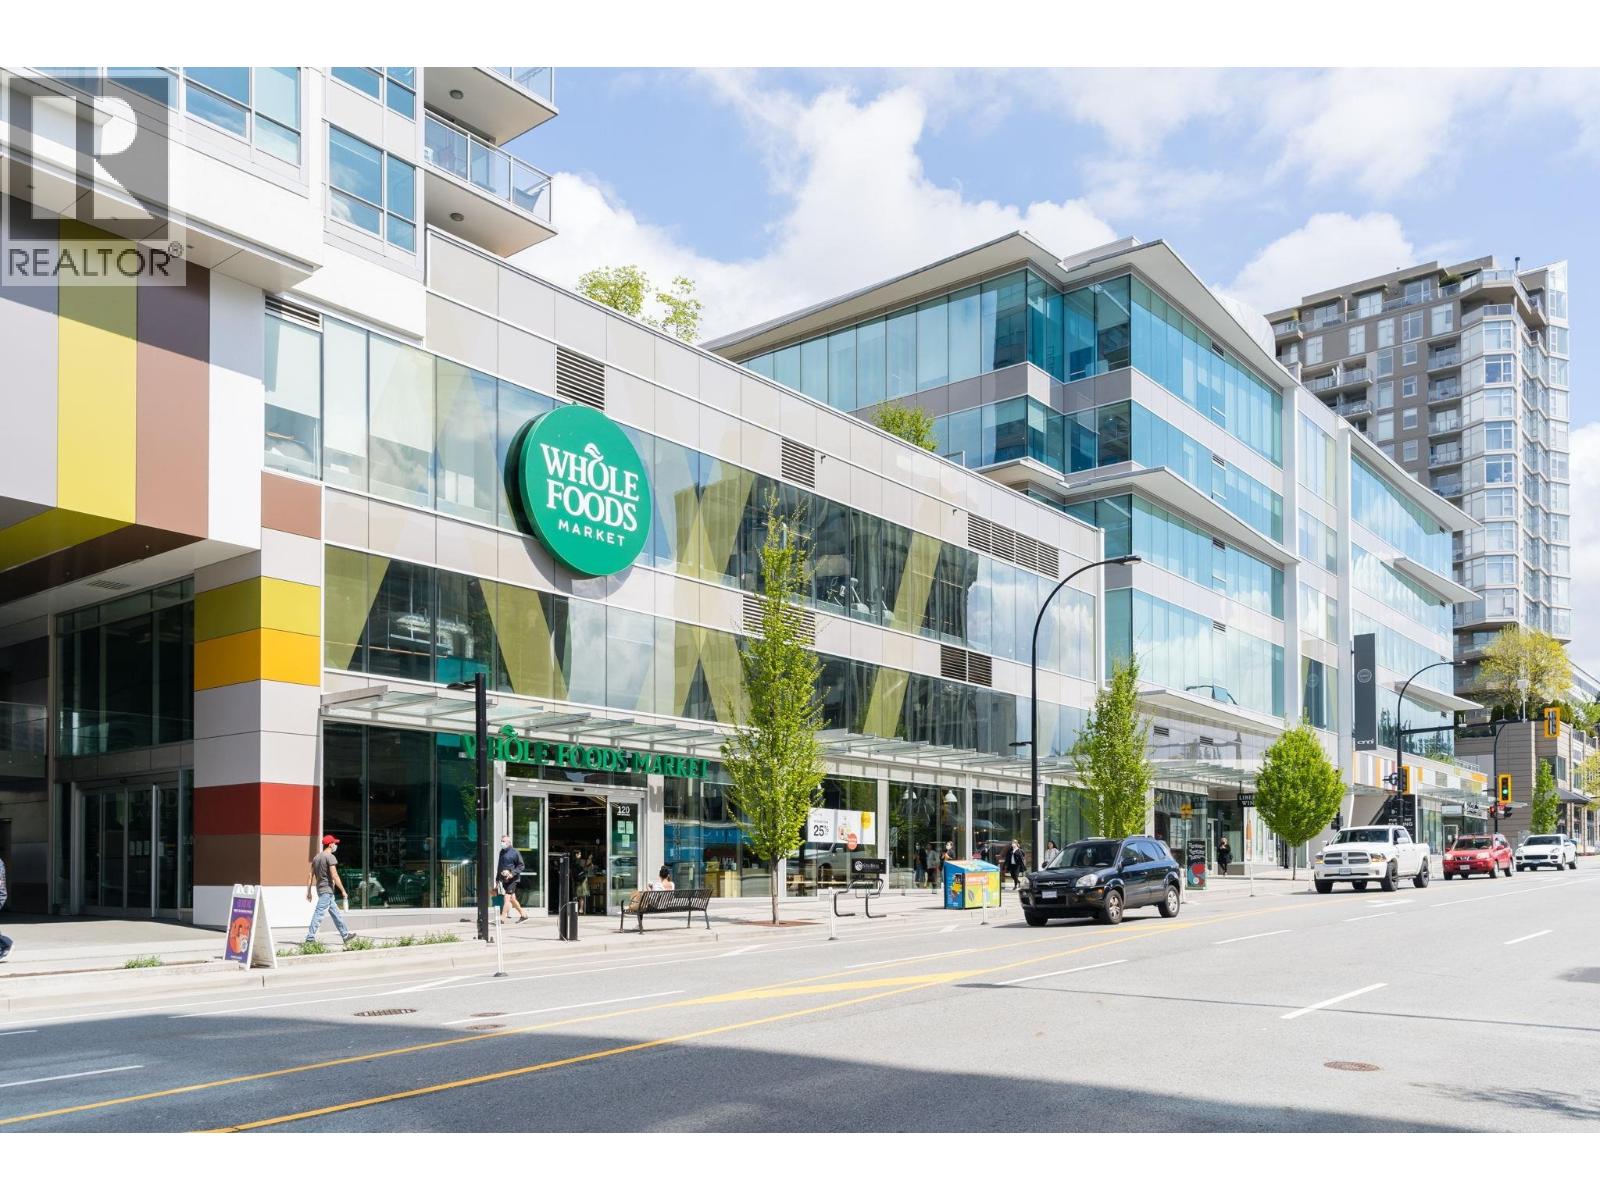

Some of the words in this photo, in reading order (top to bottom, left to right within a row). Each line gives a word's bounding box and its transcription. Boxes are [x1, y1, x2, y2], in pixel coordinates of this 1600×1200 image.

[540, 442, 640, 501] WHOLE
[546, 478, 638, 532] FOODS
[558, 519, 625, 547] MARKET
[556, 743, 629, 773] FOODS
[631, 751, 711, 780] MARKET
[617, 806, 631, 814] 120
